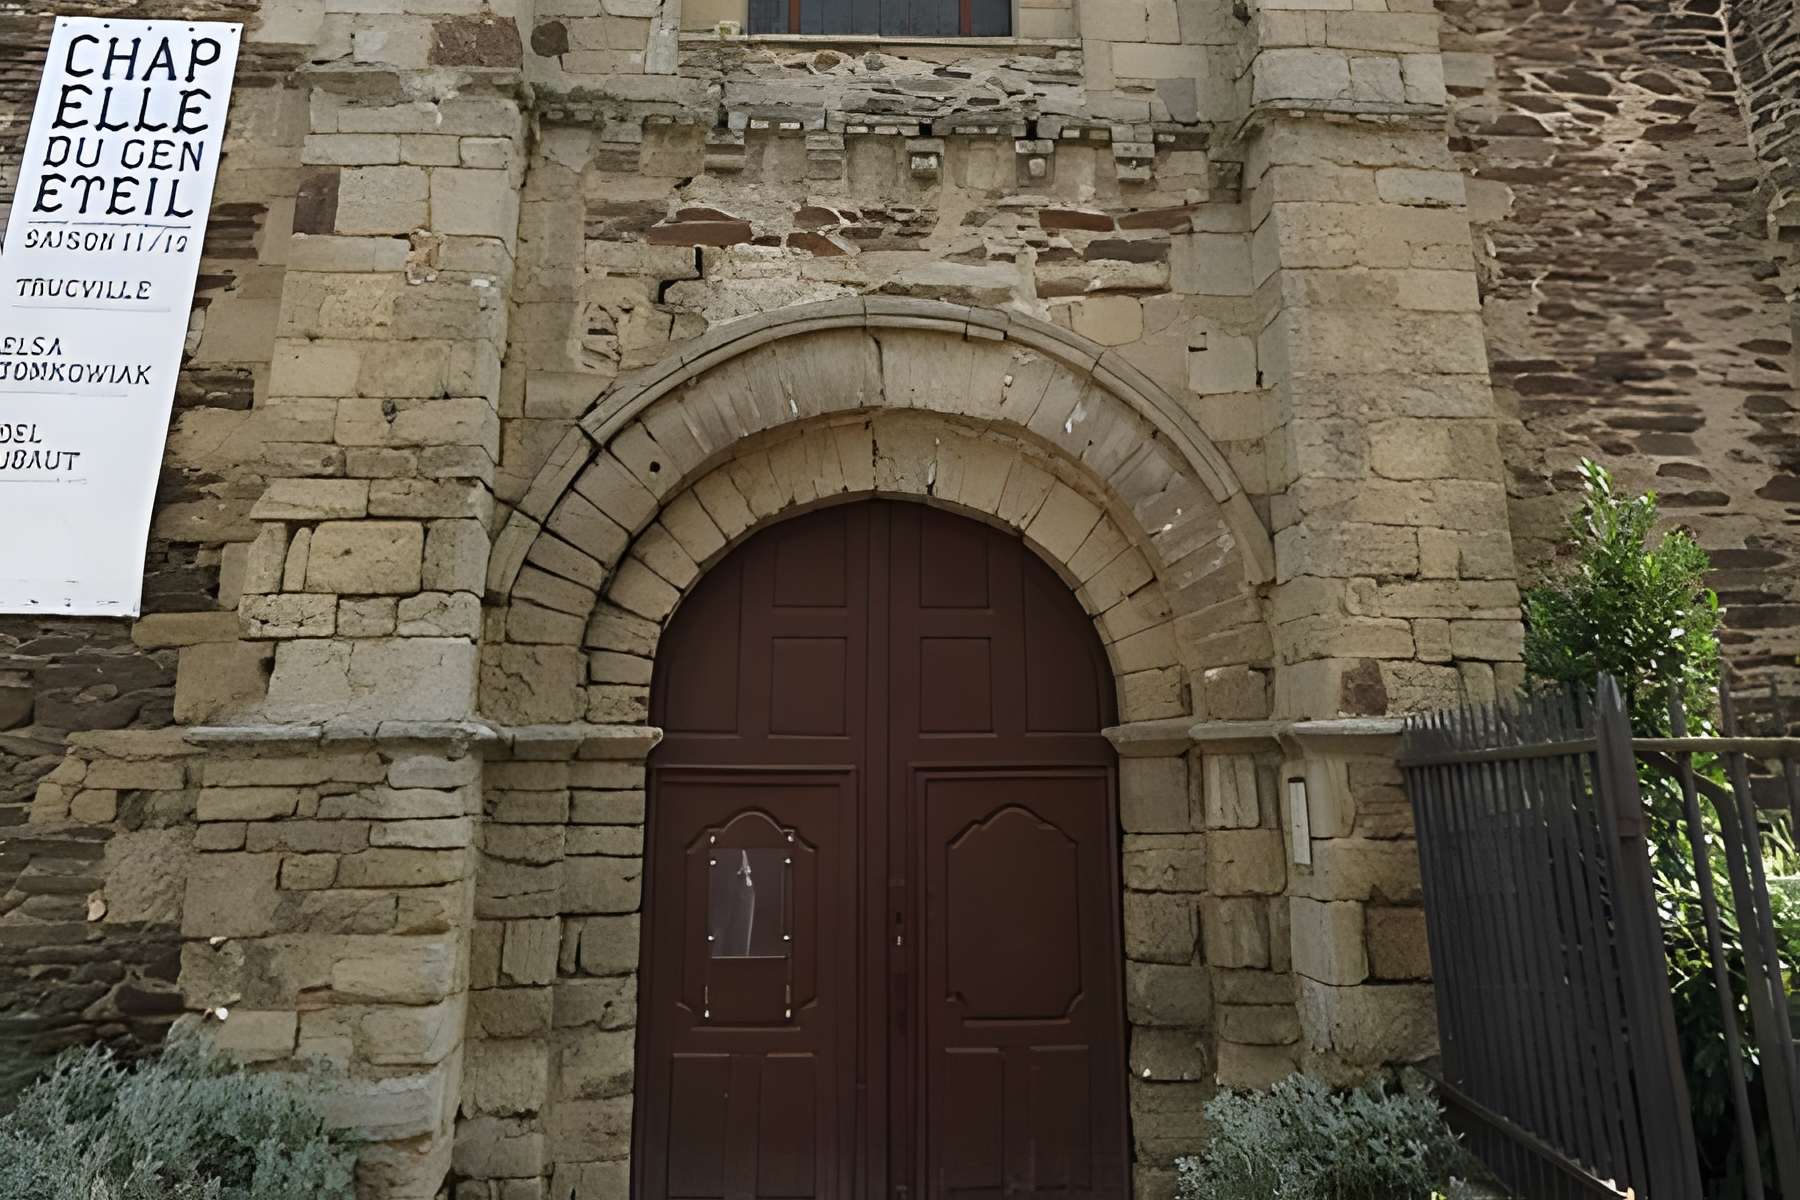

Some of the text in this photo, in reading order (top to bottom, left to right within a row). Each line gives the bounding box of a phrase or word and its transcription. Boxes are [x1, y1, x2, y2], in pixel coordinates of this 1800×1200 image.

[65, 34, 222, 82] CHAP
[51, 84, 212, 135] ELLE
[43, 136, 205, 172] DU GEN
[32, 173, 194, 218] ETEIL
[24, 227, 189, 254] SAISON 11/12
[0, 336, 62, 356] ELSA
